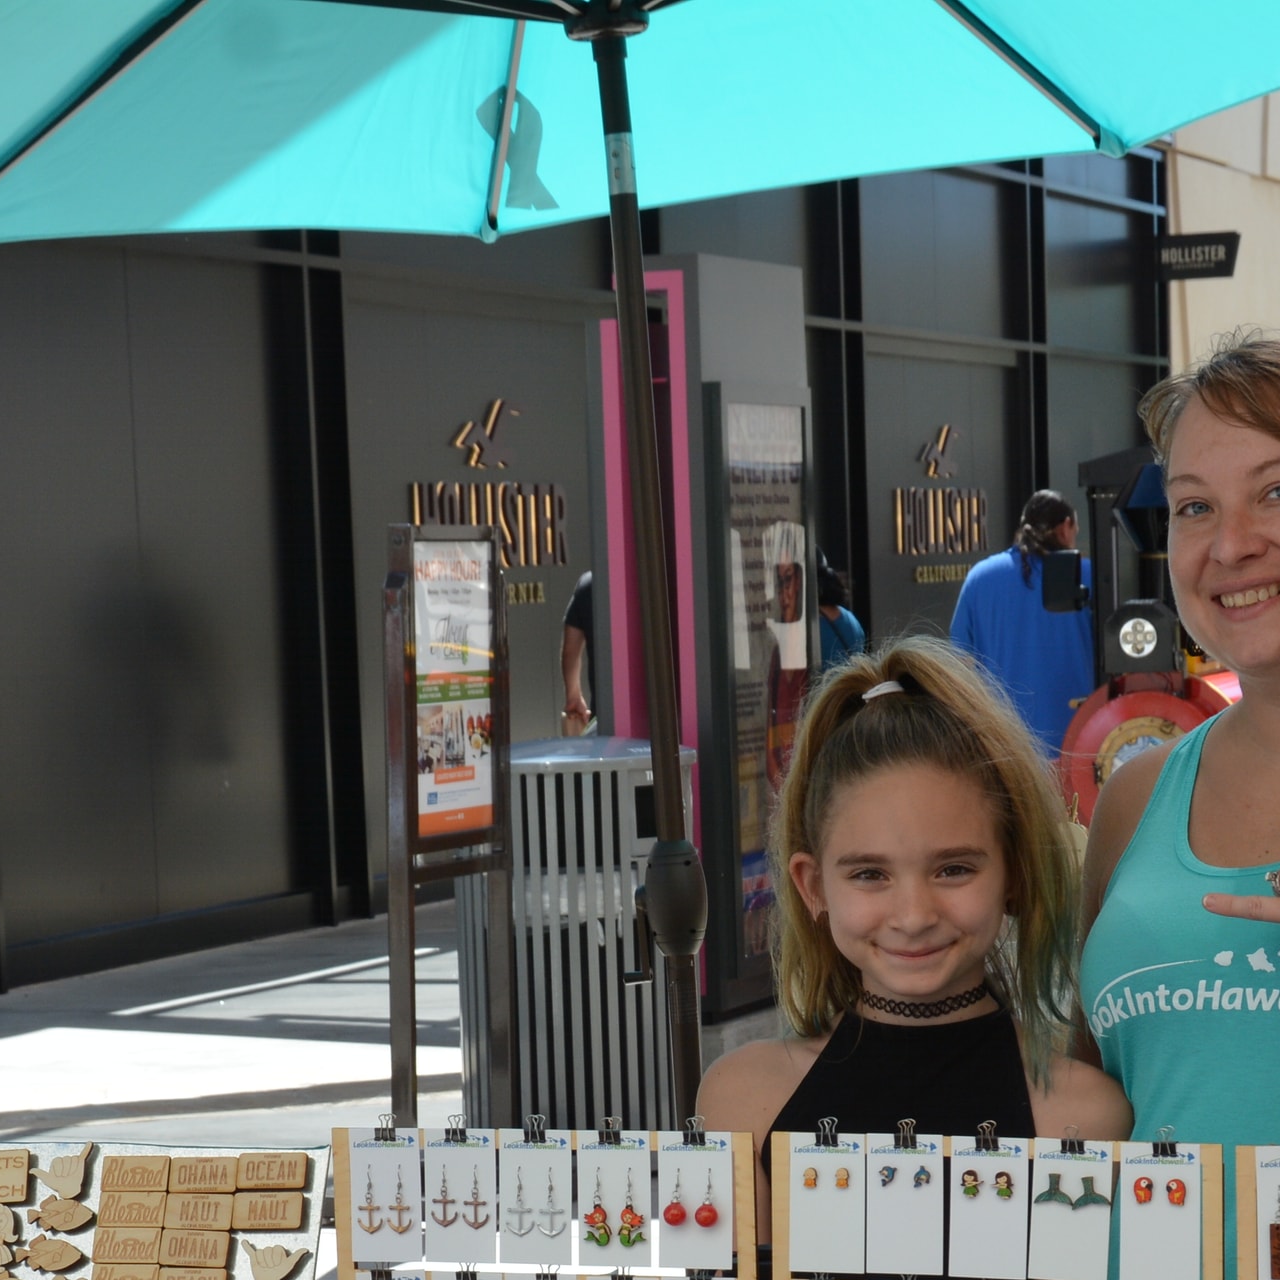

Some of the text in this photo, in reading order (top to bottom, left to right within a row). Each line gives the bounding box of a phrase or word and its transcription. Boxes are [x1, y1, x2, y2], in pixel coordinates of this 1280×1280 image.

[1162, 245, 1225, 264] HOLLISTER
[178, 1167, 227, 1186] OHANA
[245, 1161, 298, 1181] OCEAN
[180, 1203, 219, 1221] MAUI
